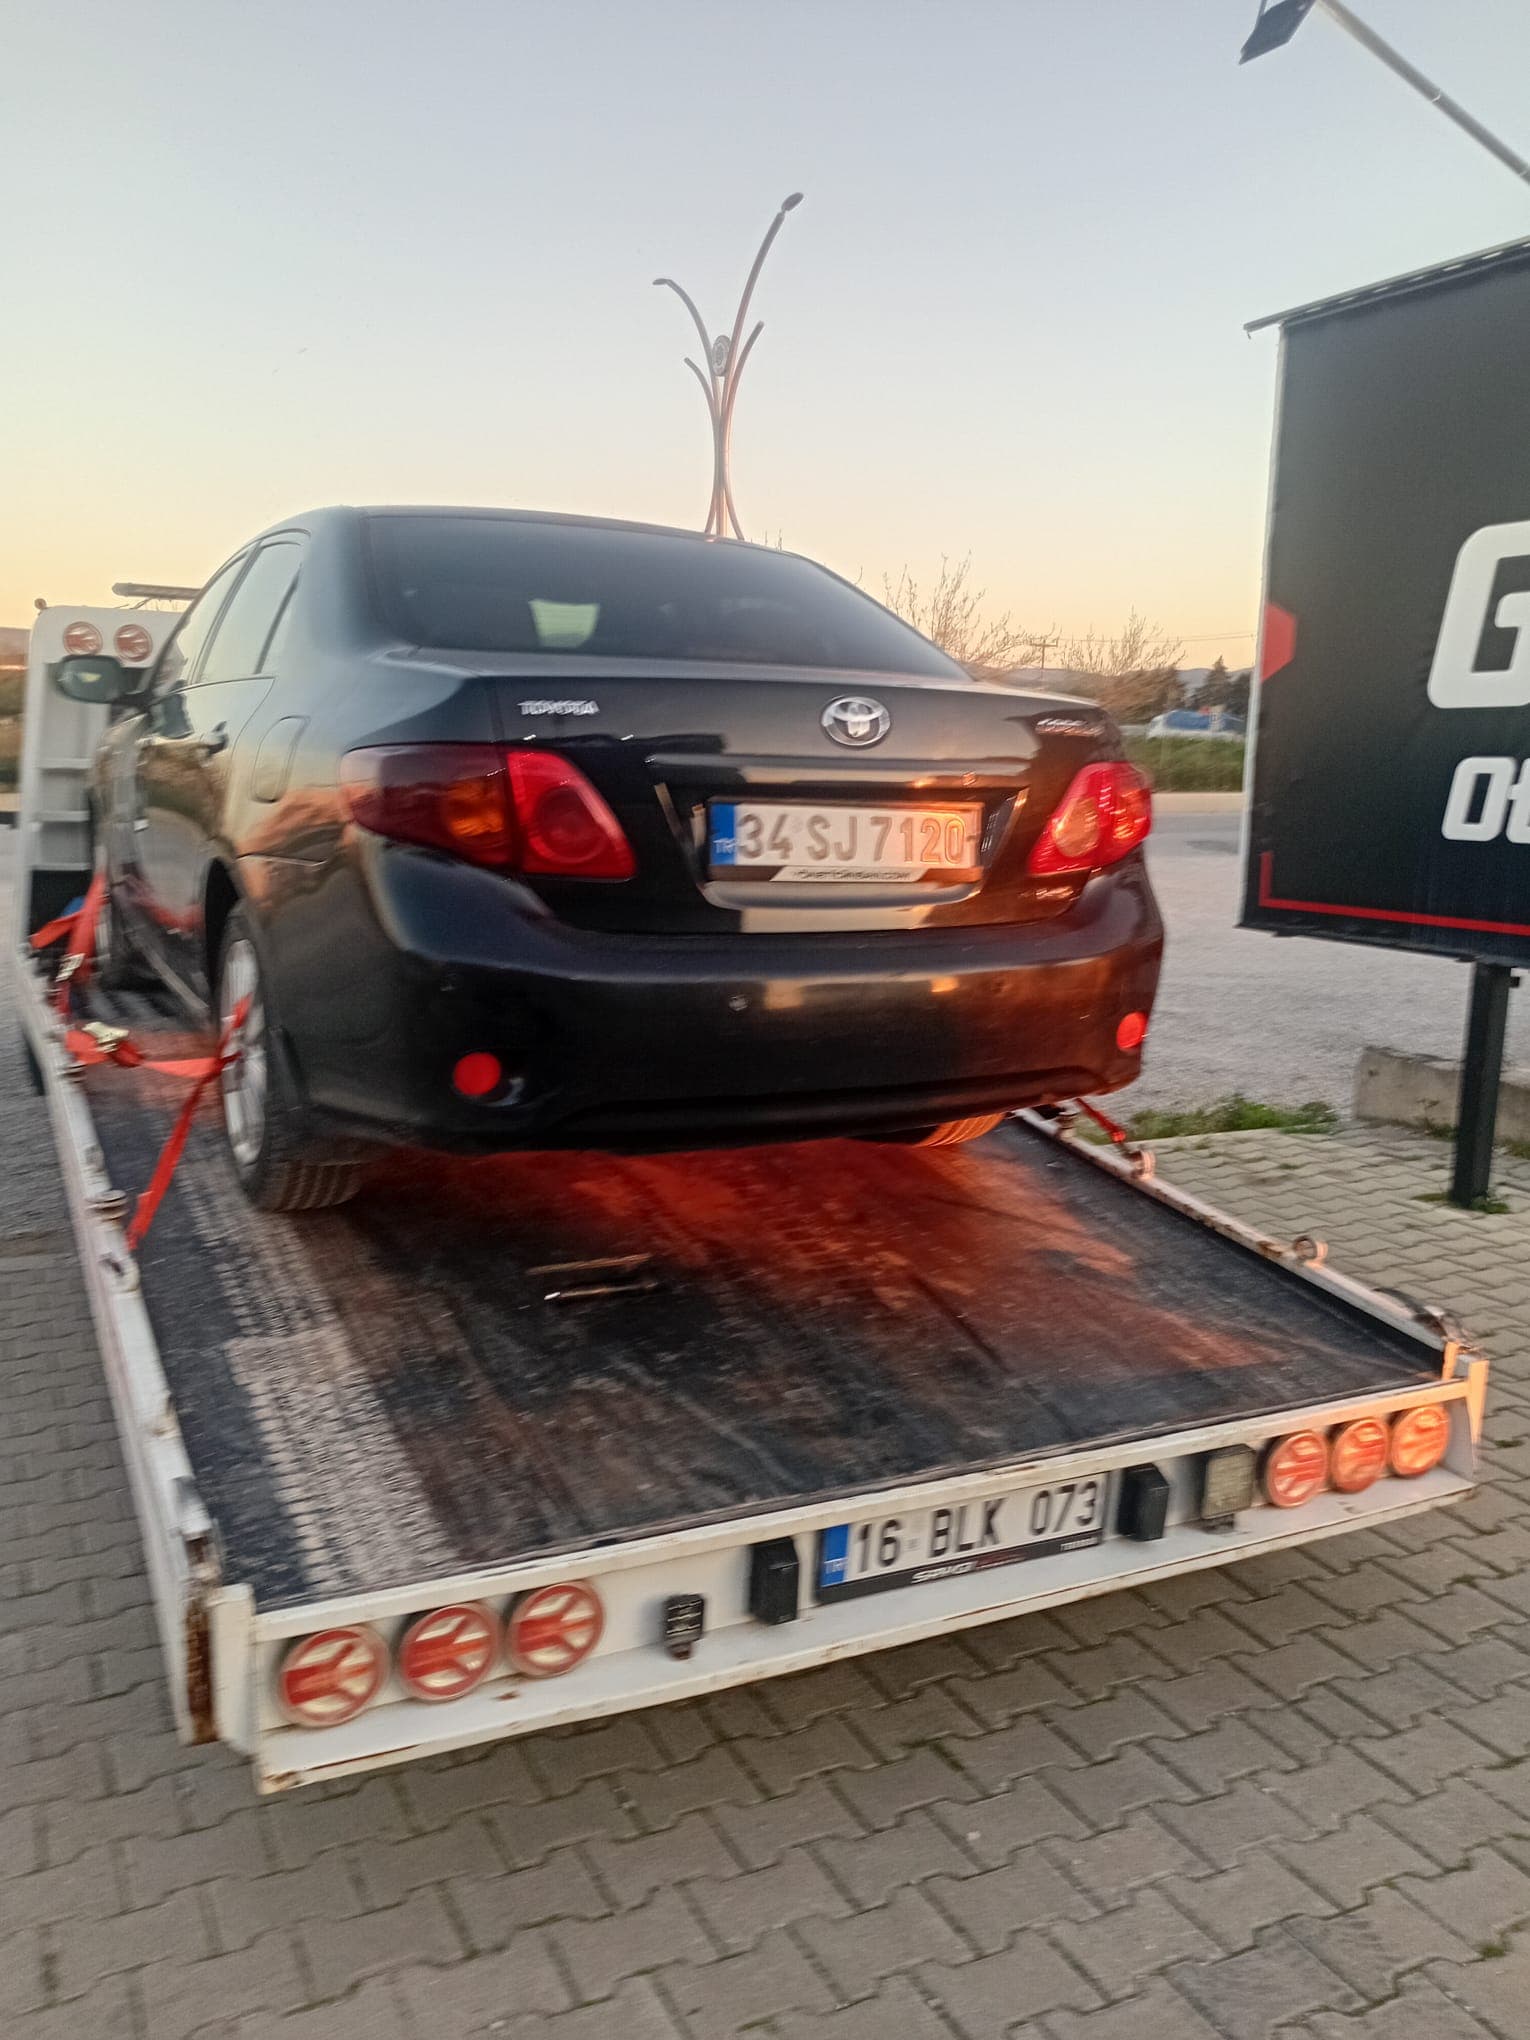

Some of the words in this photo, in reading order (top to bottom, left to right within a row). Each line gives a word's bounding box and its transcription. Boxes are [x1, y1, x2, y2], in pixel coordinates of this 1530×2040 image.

[737, 813, 794, 860] 34
[806, 815, 858, 861] SJ
[870, 816, 966, 864] 7120
[857, 1518, 903, 1573] 16
[929, 1497, 1008, 1558] BLK
[1031, 1480, 1098, 1536] 073
